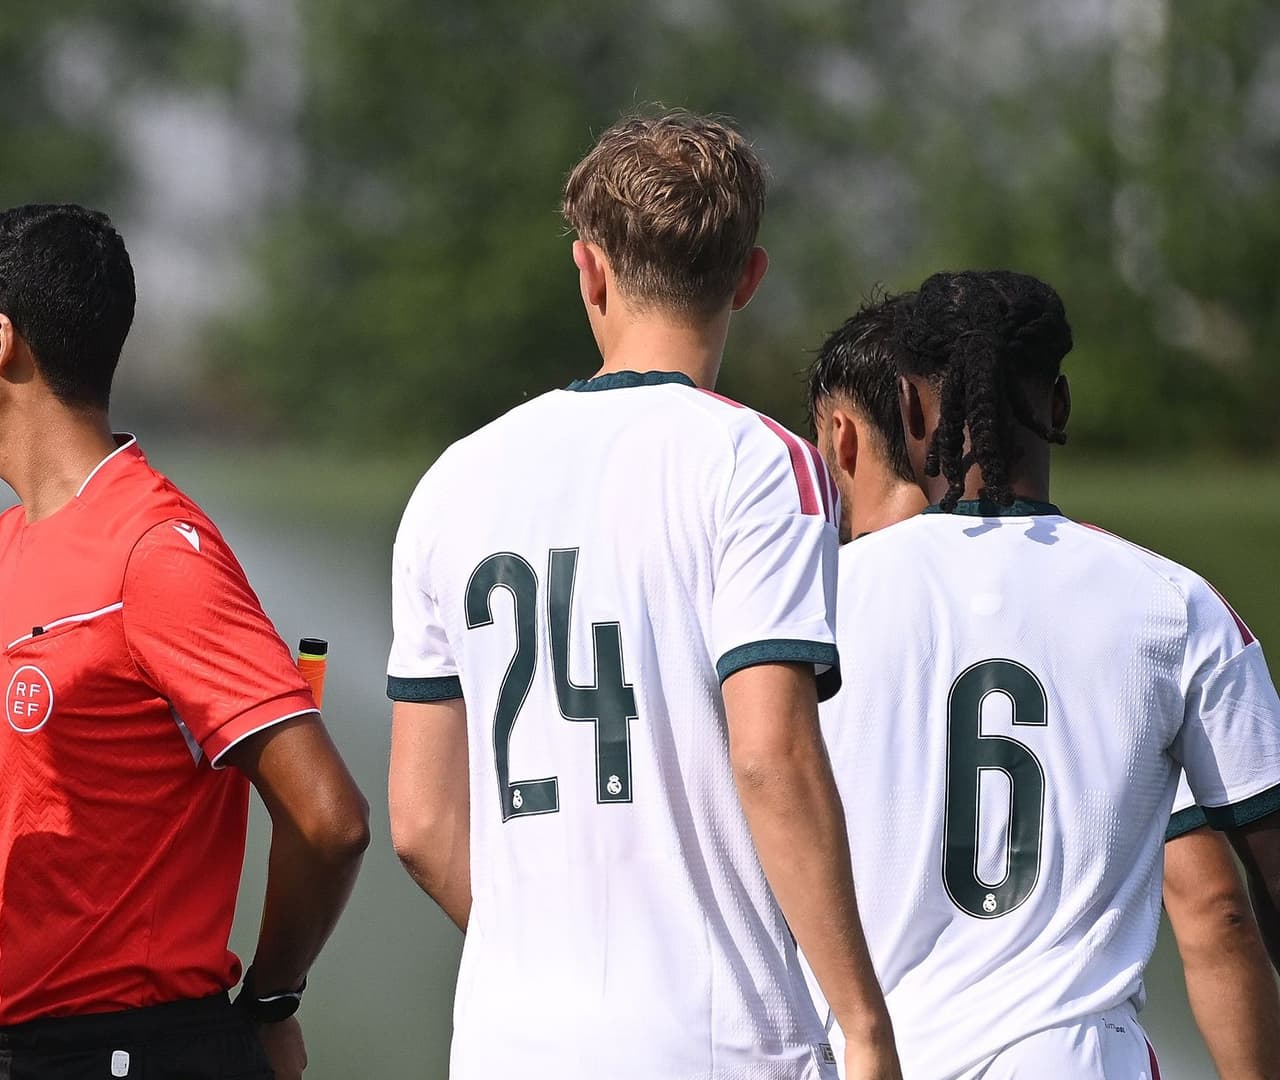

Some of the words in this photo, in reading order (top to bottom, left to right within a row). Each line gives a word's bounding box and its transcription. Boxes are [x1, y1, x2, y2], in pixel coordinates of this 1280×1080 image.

[13, 701, 39, 717] EF
[15, 681, 41, 698] RF
[463, 546, 639, 823] 24
[942, 657, 1048, 920] 6
